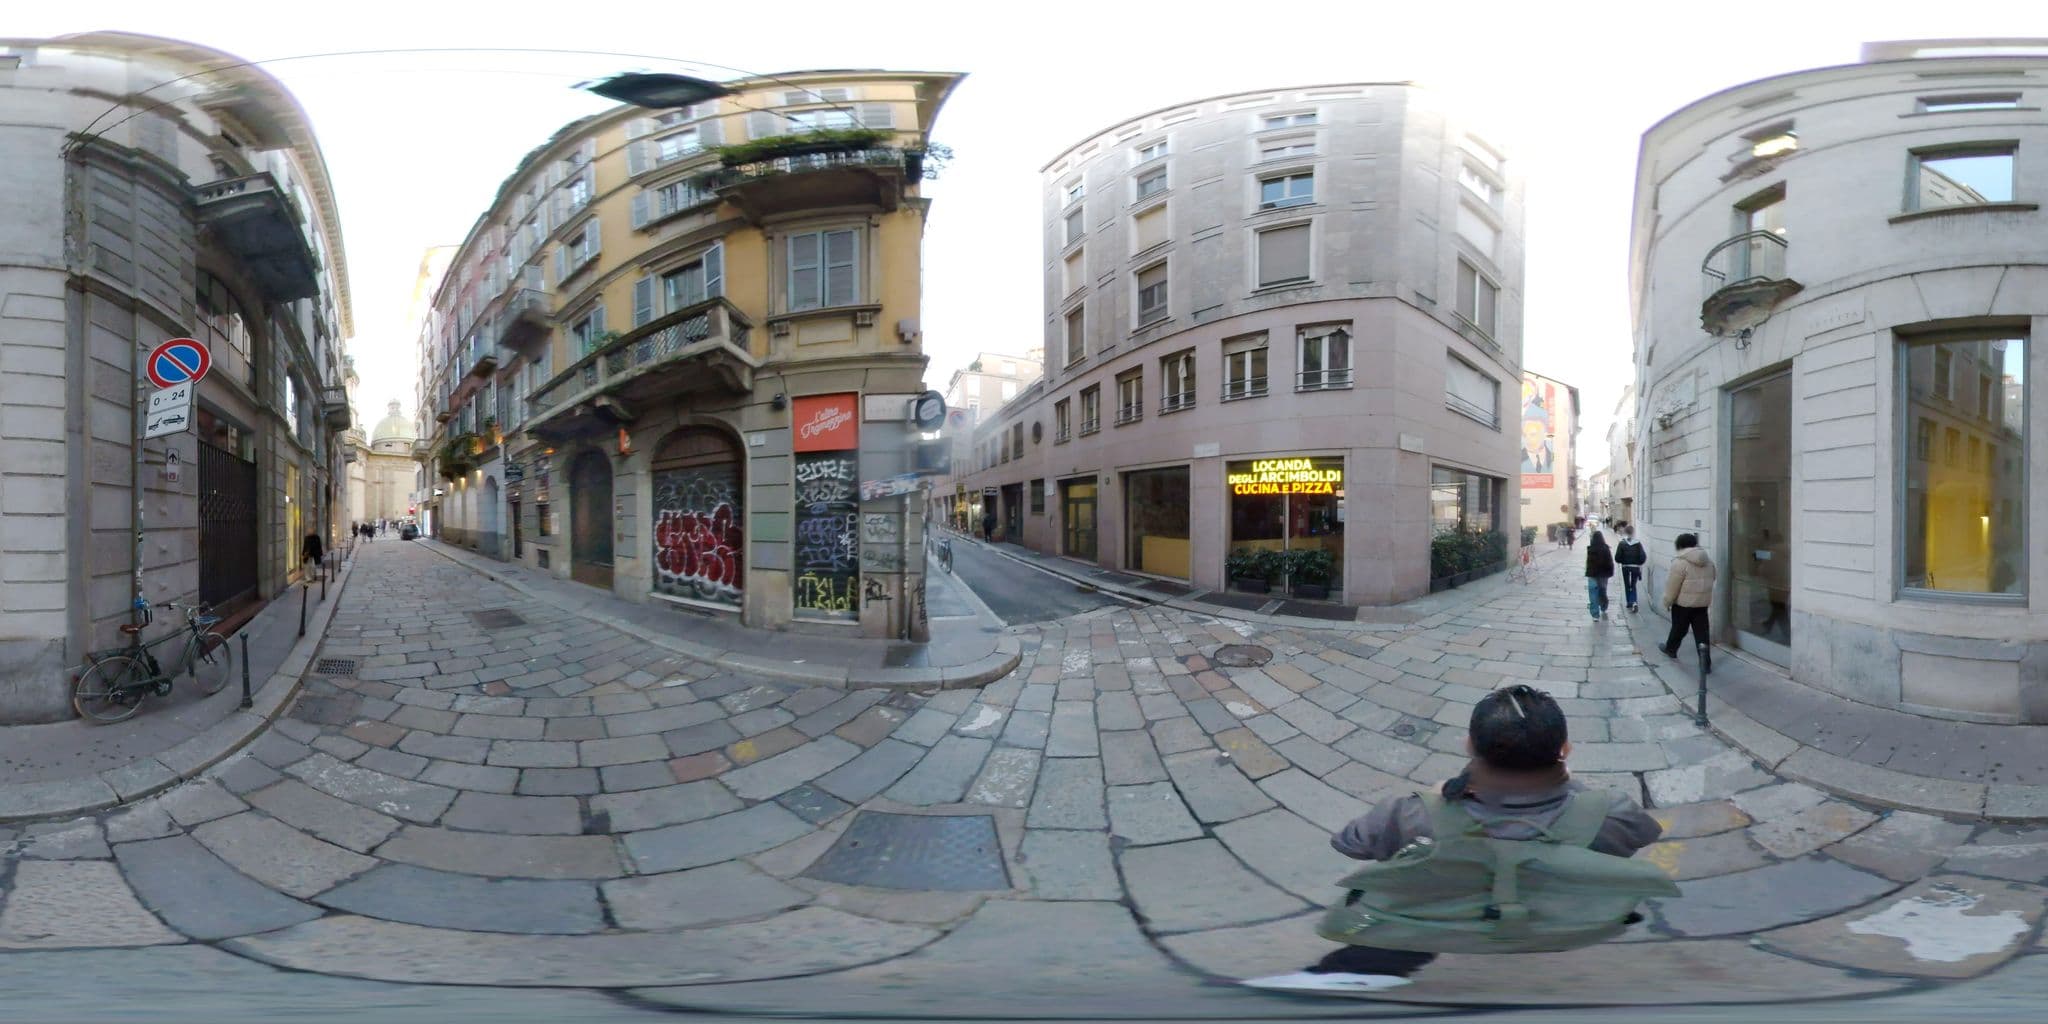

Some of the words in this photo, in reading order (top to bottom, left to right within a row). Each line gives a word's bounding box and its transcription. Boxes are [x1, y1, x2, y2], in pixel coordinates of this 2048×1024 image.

[154, 397, 160, 406] 0
[172, 389, 185, 401] 24
[1253, 459, 1312, 472] LOCANDA
[1229, 474, 1258, 484] DEGLI
[1259, 470, 1341, 483] ARCIMBOLDI
[1235, 483, 1280, 494] CUCINA
[1282, 484, 1289, 494] E
[1292, 482, 1333, 494] PIZZA
